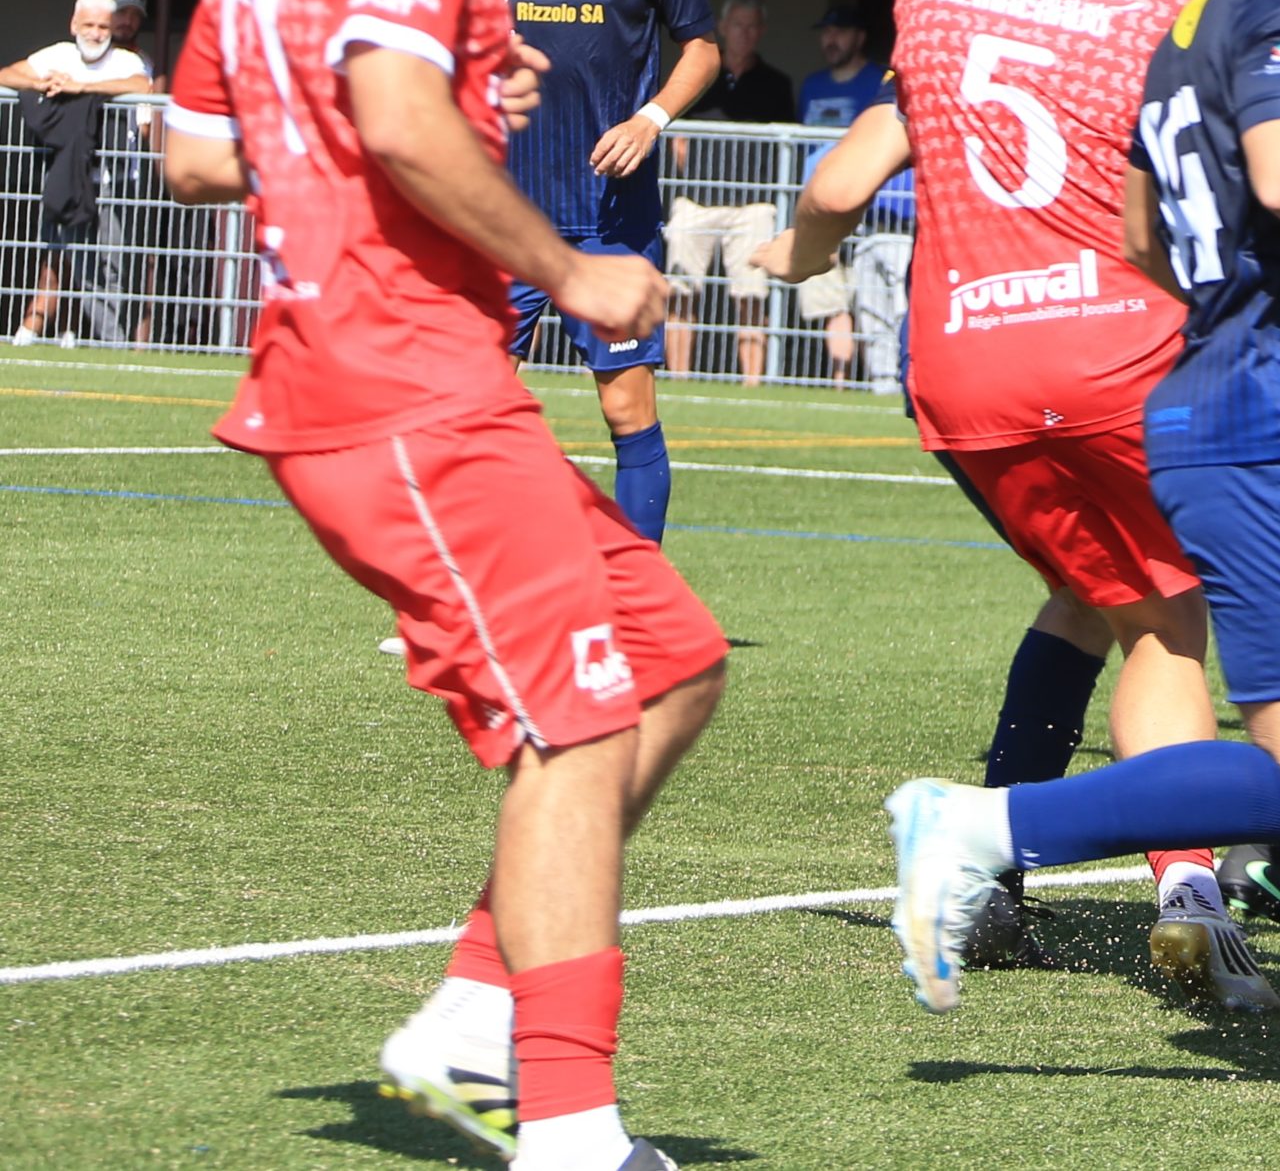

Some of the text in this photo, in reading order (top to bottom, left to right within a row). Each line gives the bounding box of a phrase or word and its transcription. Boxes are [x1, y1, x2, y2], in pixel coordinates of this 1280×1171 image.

[516, 1, 604, 24] Rizzolo SA
[960, 34, 1068, 209] 5
[944, 248, 1099, 334] jouval
[1127, 298, 1148, 312] SA
[609, 338, 638, 353] JAKO
